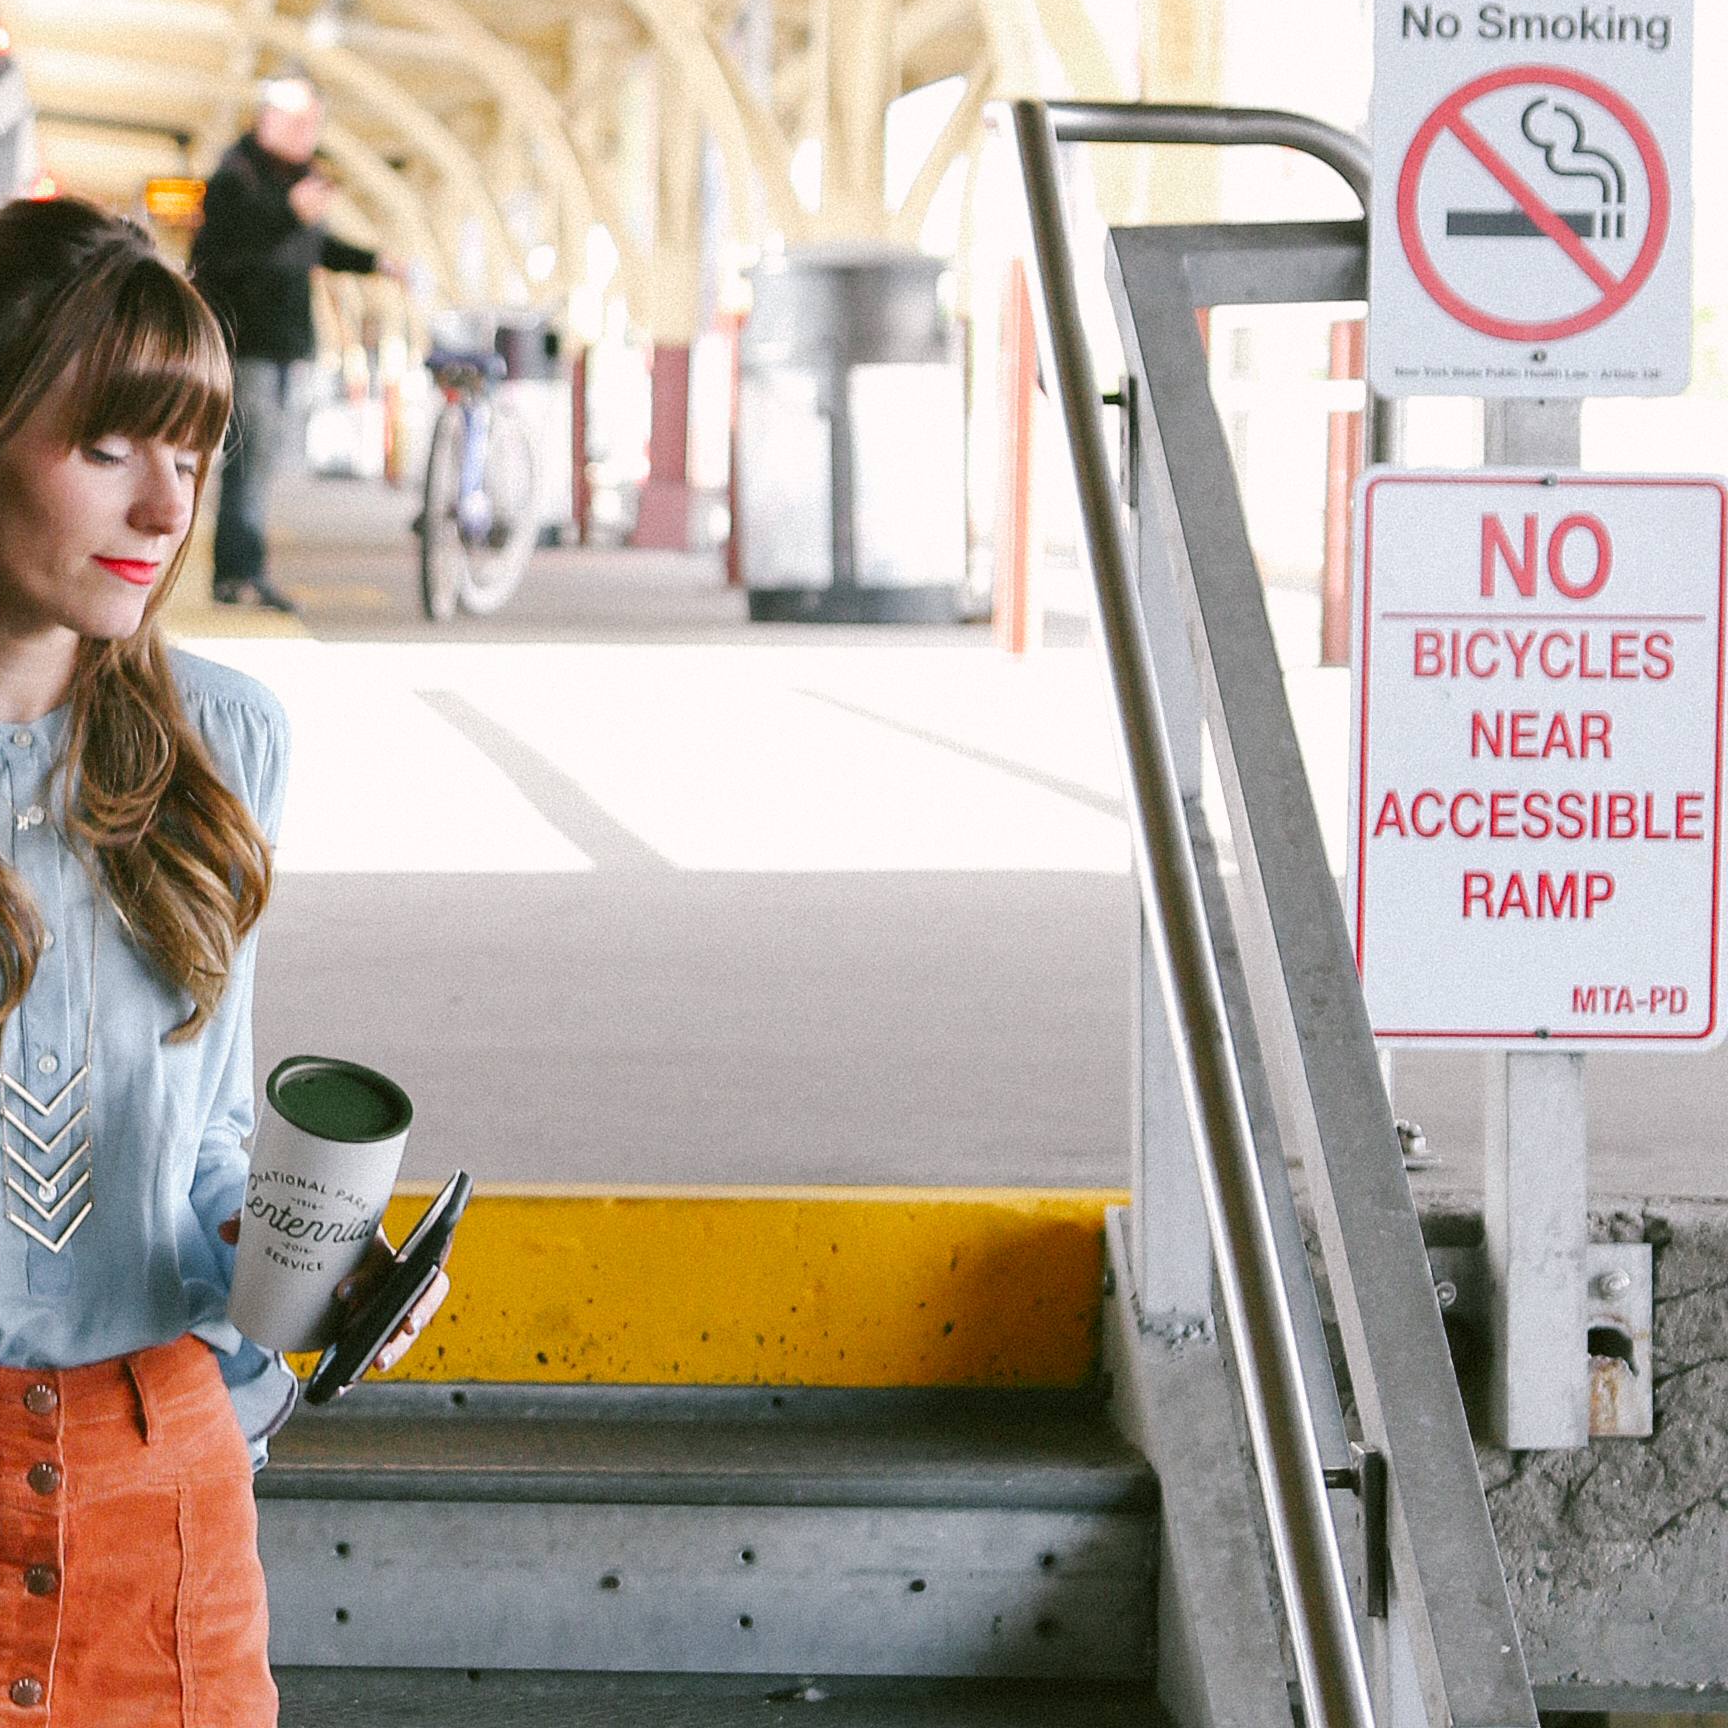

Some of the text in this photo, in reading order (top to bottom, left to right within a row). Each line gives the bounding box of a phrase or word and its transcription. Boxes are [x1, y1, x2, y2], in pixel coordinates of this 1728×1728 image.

[1402, 4, 1672, 49] No Smoking
[1480, 511, 1613, 600] NO
[1413, 630, 1674, 679] BICYCLES
[1470, 709, 1612, 759] NEAR
[1373, 789, 1705, 840] ACCESSIBLE
[1462, 870, 1616, 919] RAMP
[1572, 985, 1689, 1014] MTA-PD
[258, 1171, 327, 1194] NATIONAL
[265, 1246, 324, 1271] SERVICE
